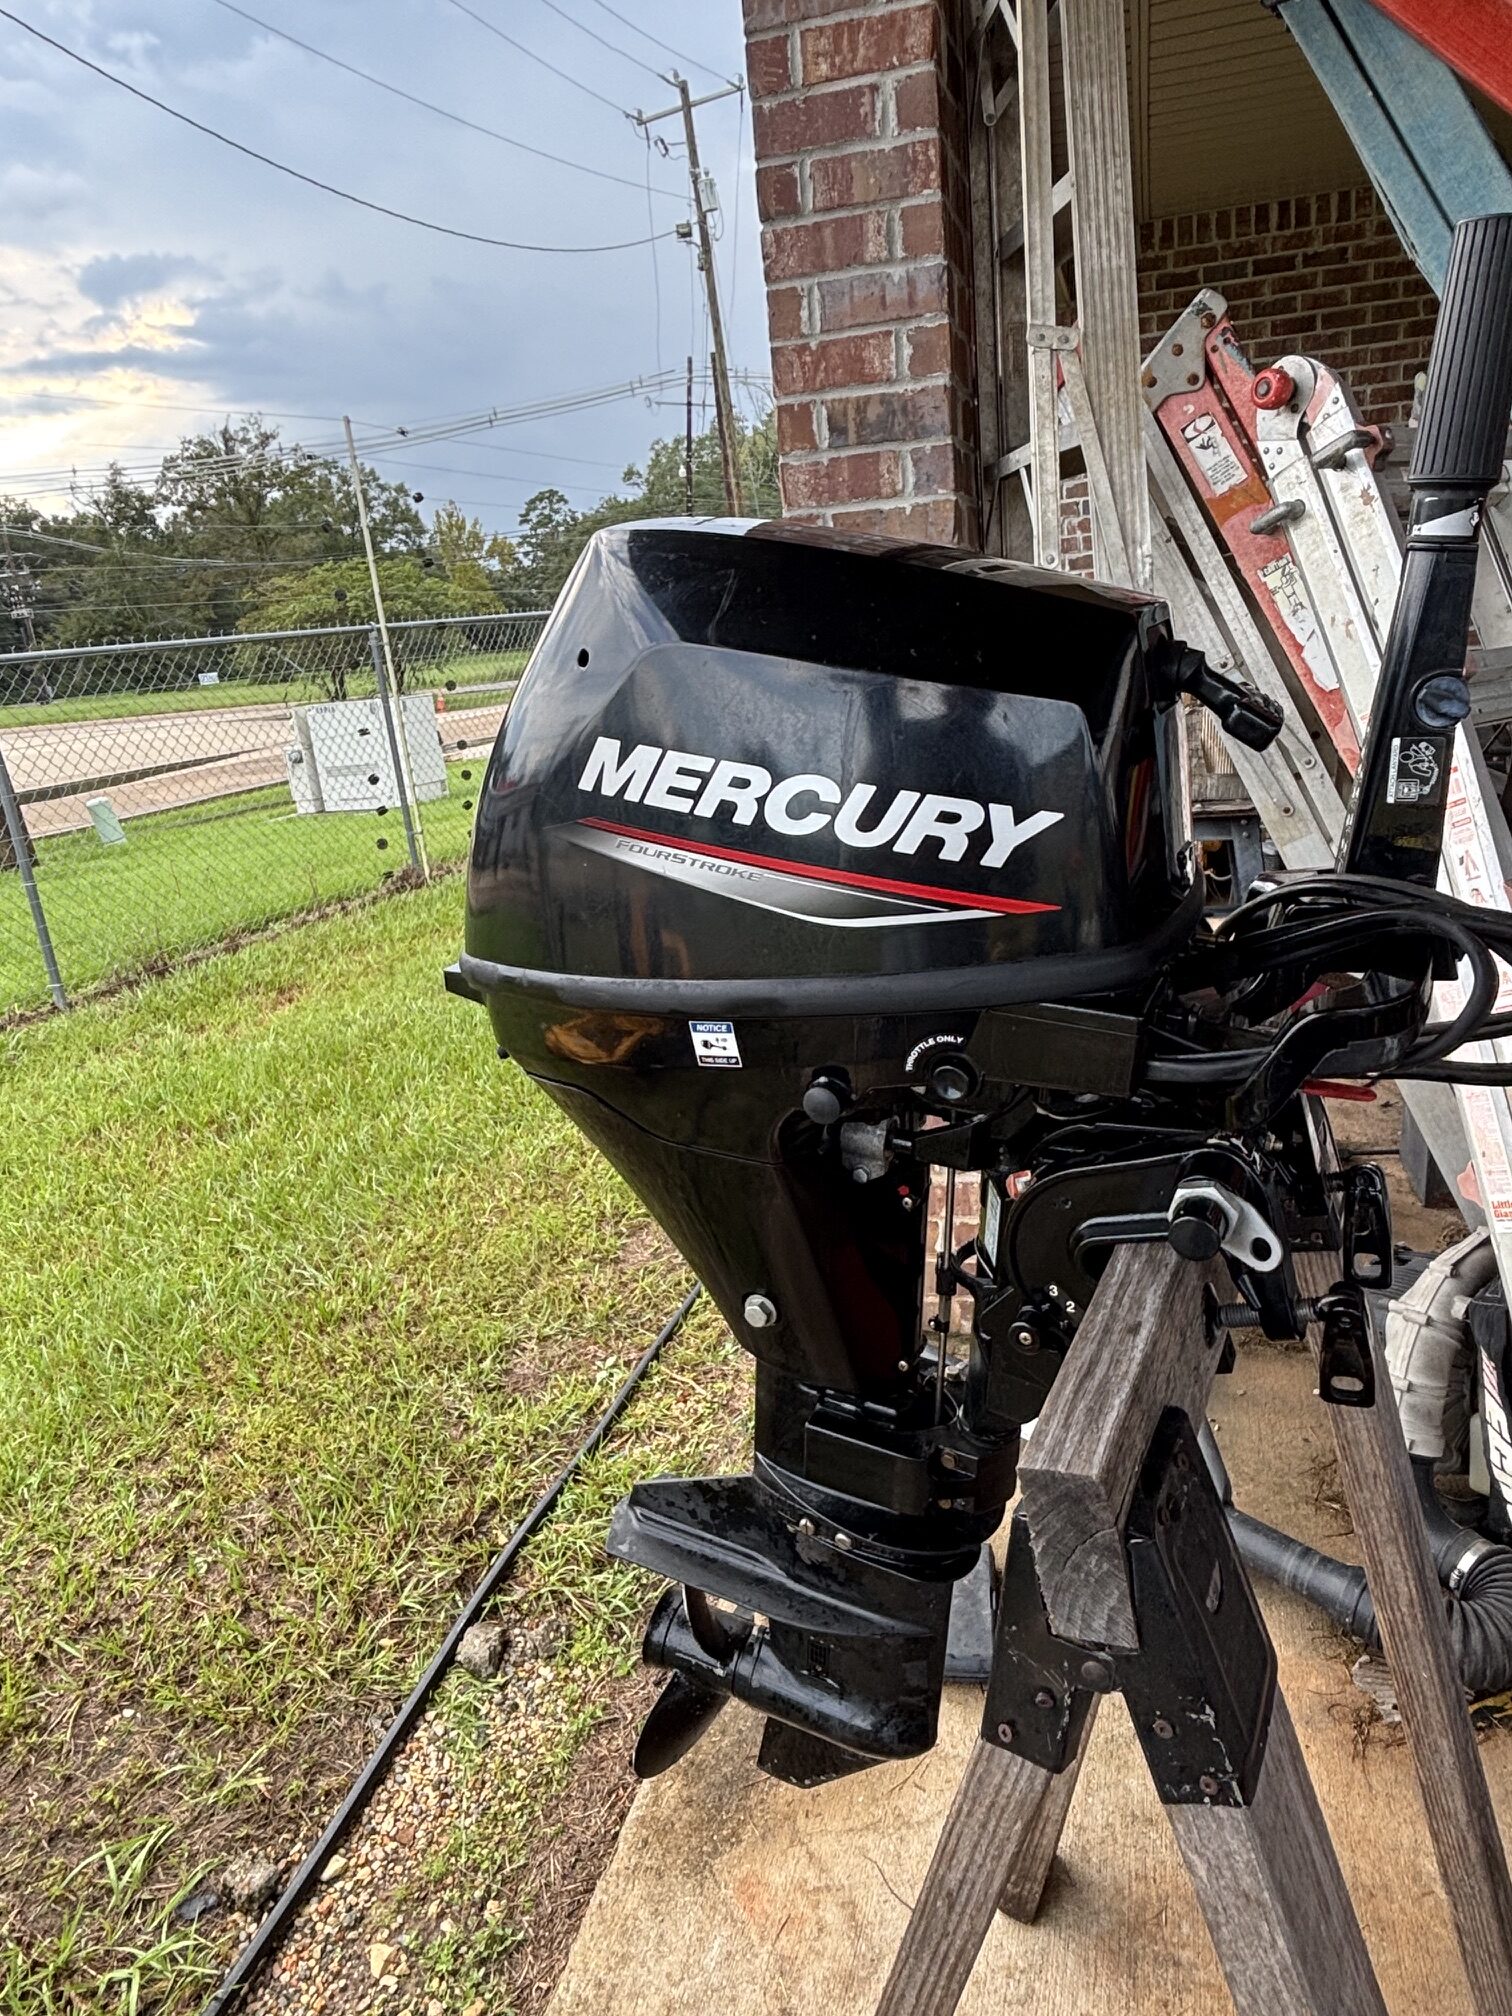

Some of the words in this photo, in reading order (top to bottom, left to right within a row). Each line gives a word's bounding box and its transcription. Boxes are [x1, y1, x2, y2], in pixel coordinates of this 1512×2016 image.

[577, 736, 1065, 868] MERCURY
[615, 839, 764, 882] FOURSTROKE
[697, 1024, 727, 1032] NOTICE
[905, 1038, 935, 1071] THROTTLE
[936, 1035, 964, 1044] ONLY
[1049, 1284, 1058, 1297] 3
[1065, 1300, 1076, 1313] 2
